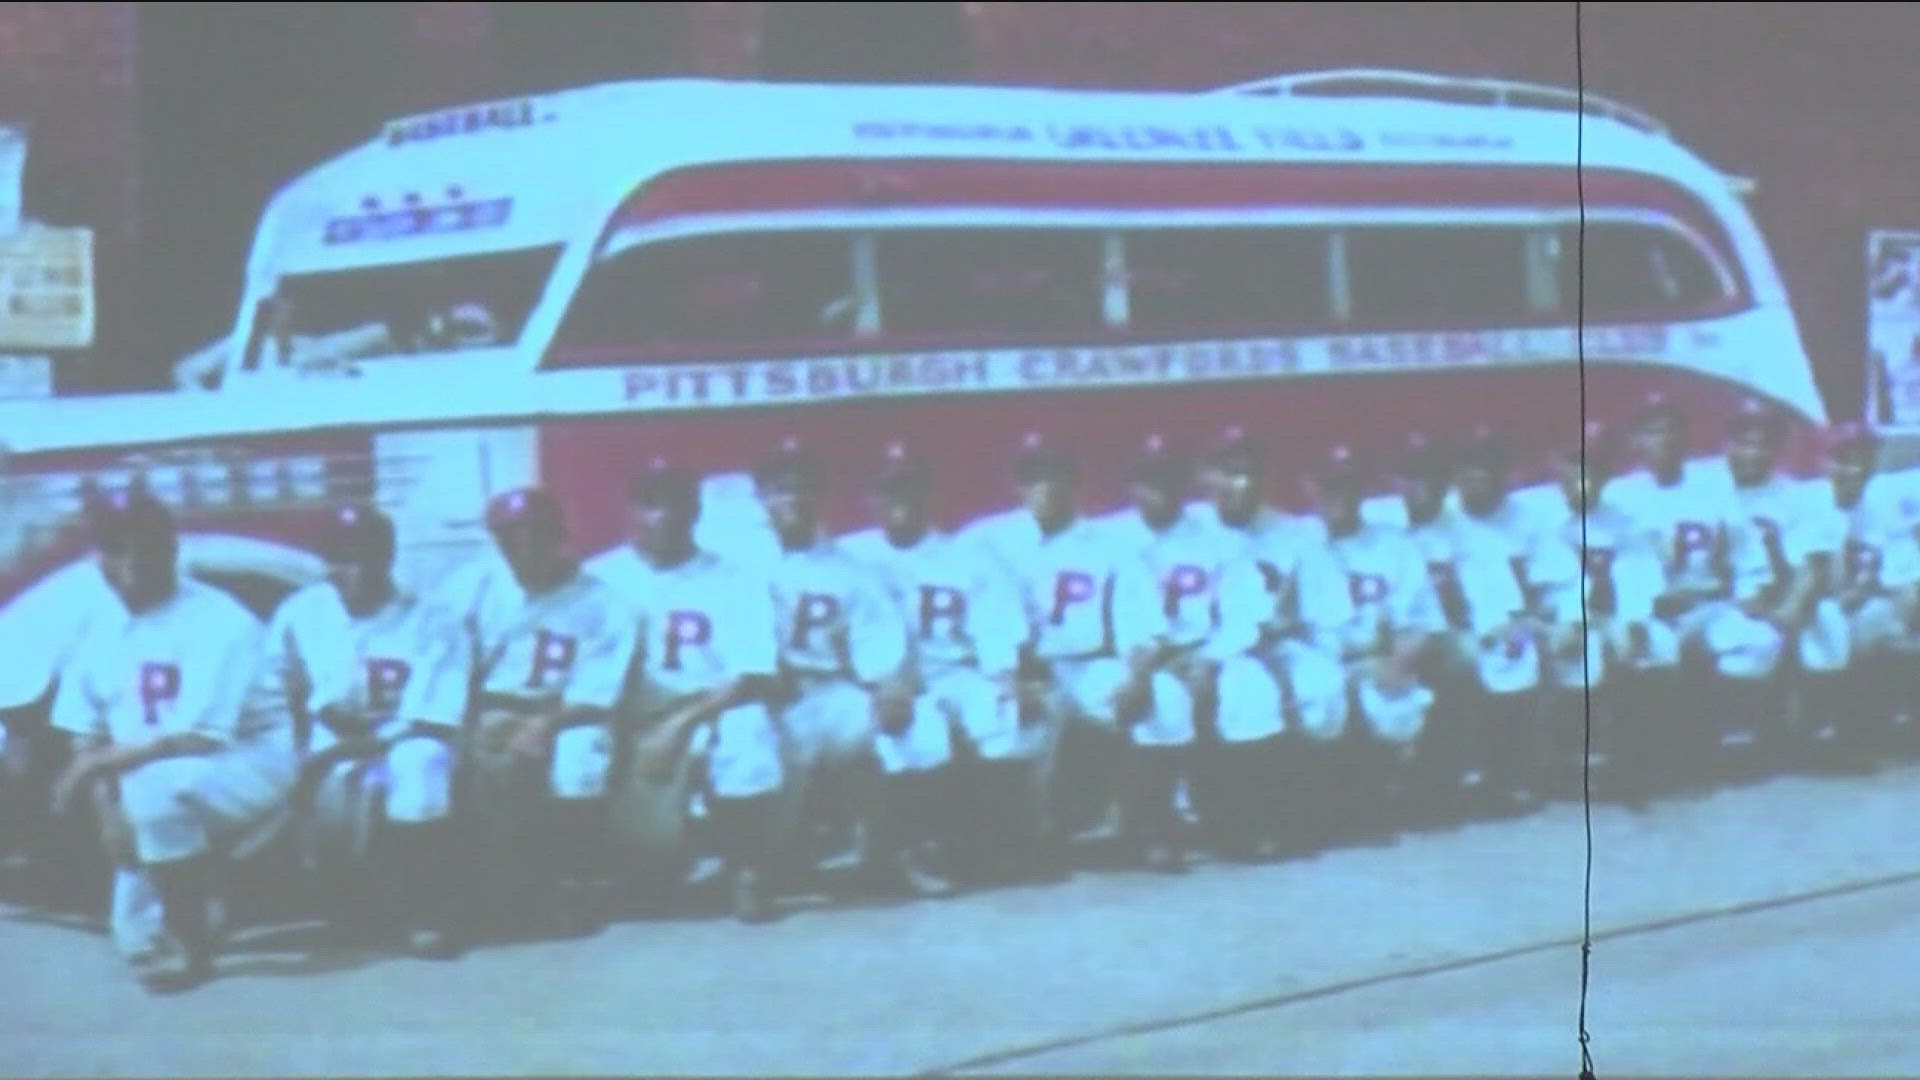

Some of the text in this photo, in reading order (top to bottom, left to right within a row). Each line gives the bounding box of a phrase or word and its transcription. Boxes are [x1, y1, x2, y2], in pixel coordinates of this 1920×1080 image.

[622, 350, 990, 402] PITTSBURGH
[1018, 337, 1299, 382] CRAWFORDS
[1050, 570, 1096, 626] P
[1164, 563, 1208, 618] P
[662, 608, 712, 672] P
[792, 591, 840, 652] P
[367, 658, 411, 711] P
[526, 628, 578, 689] P
[138, 661, 182, 727] P
